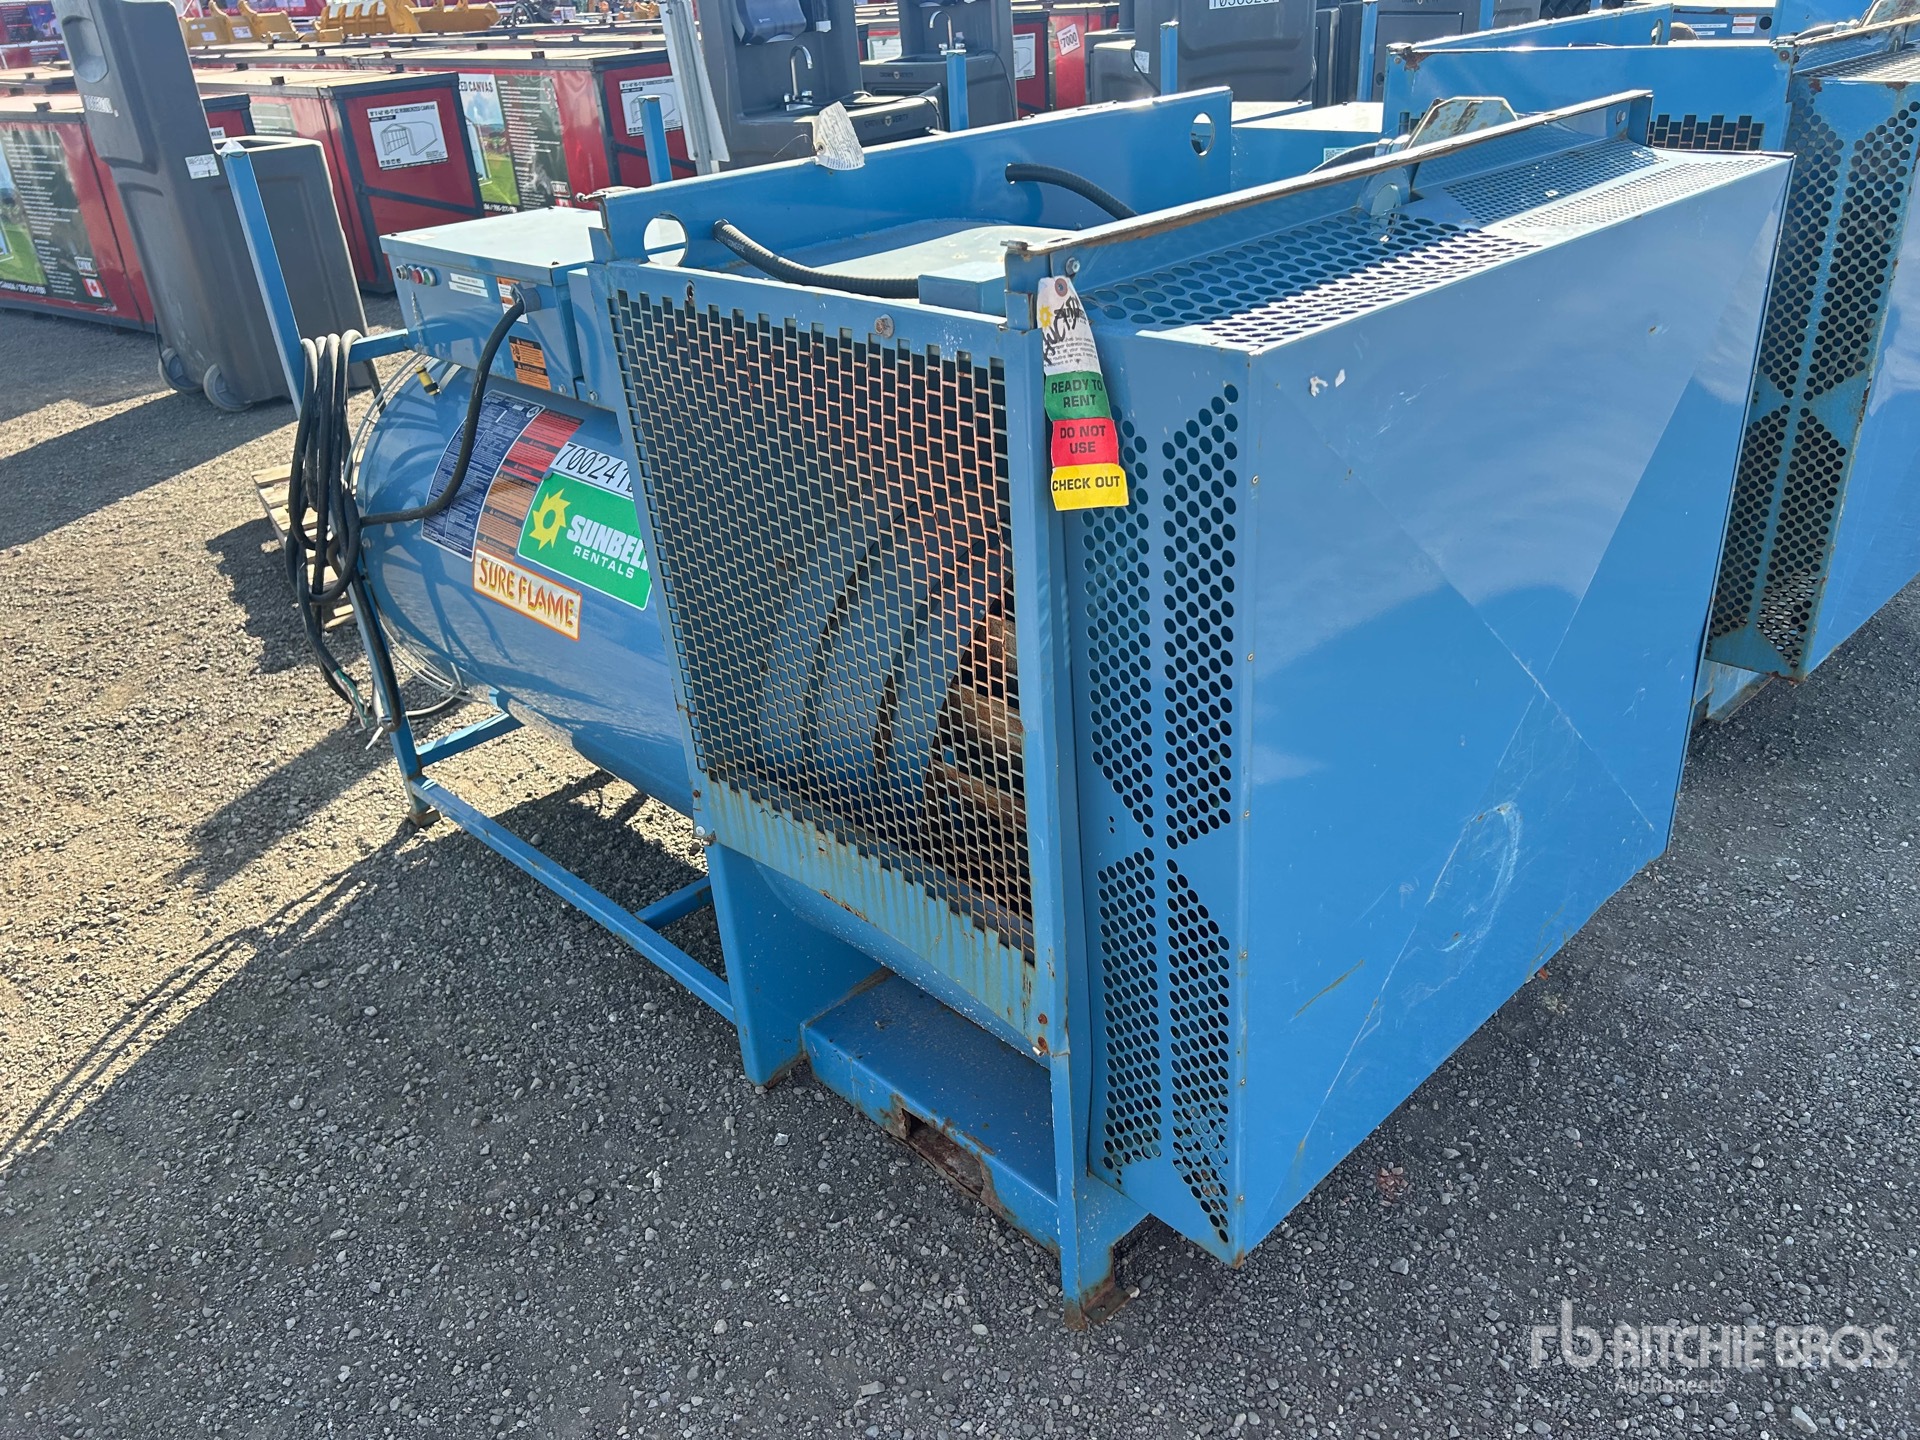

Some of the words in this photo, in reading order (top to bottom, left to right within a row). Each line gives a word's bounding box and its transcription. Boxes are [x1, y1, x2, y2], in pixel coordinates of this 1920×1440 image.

[469, 82, 494, 93] CANVAS
[1051, 380, 1089, 394] READY
[1091, 378, 1103, 391] TO
[1063, 395, 1096, 408] RENT
[1060, 427, 1076, 439] DO
[1079, 424, 1106, 438] NOT
[1069, 441, 1096, 454] USE
[1052, 477, 1091, 492] CHECK
[1095, 475, 1121, 488] OUT
[572, 546, 635, 579] RENTALS
[479, 556, 515, 600] SURE
[517, 571, 576, 628] FLAME
